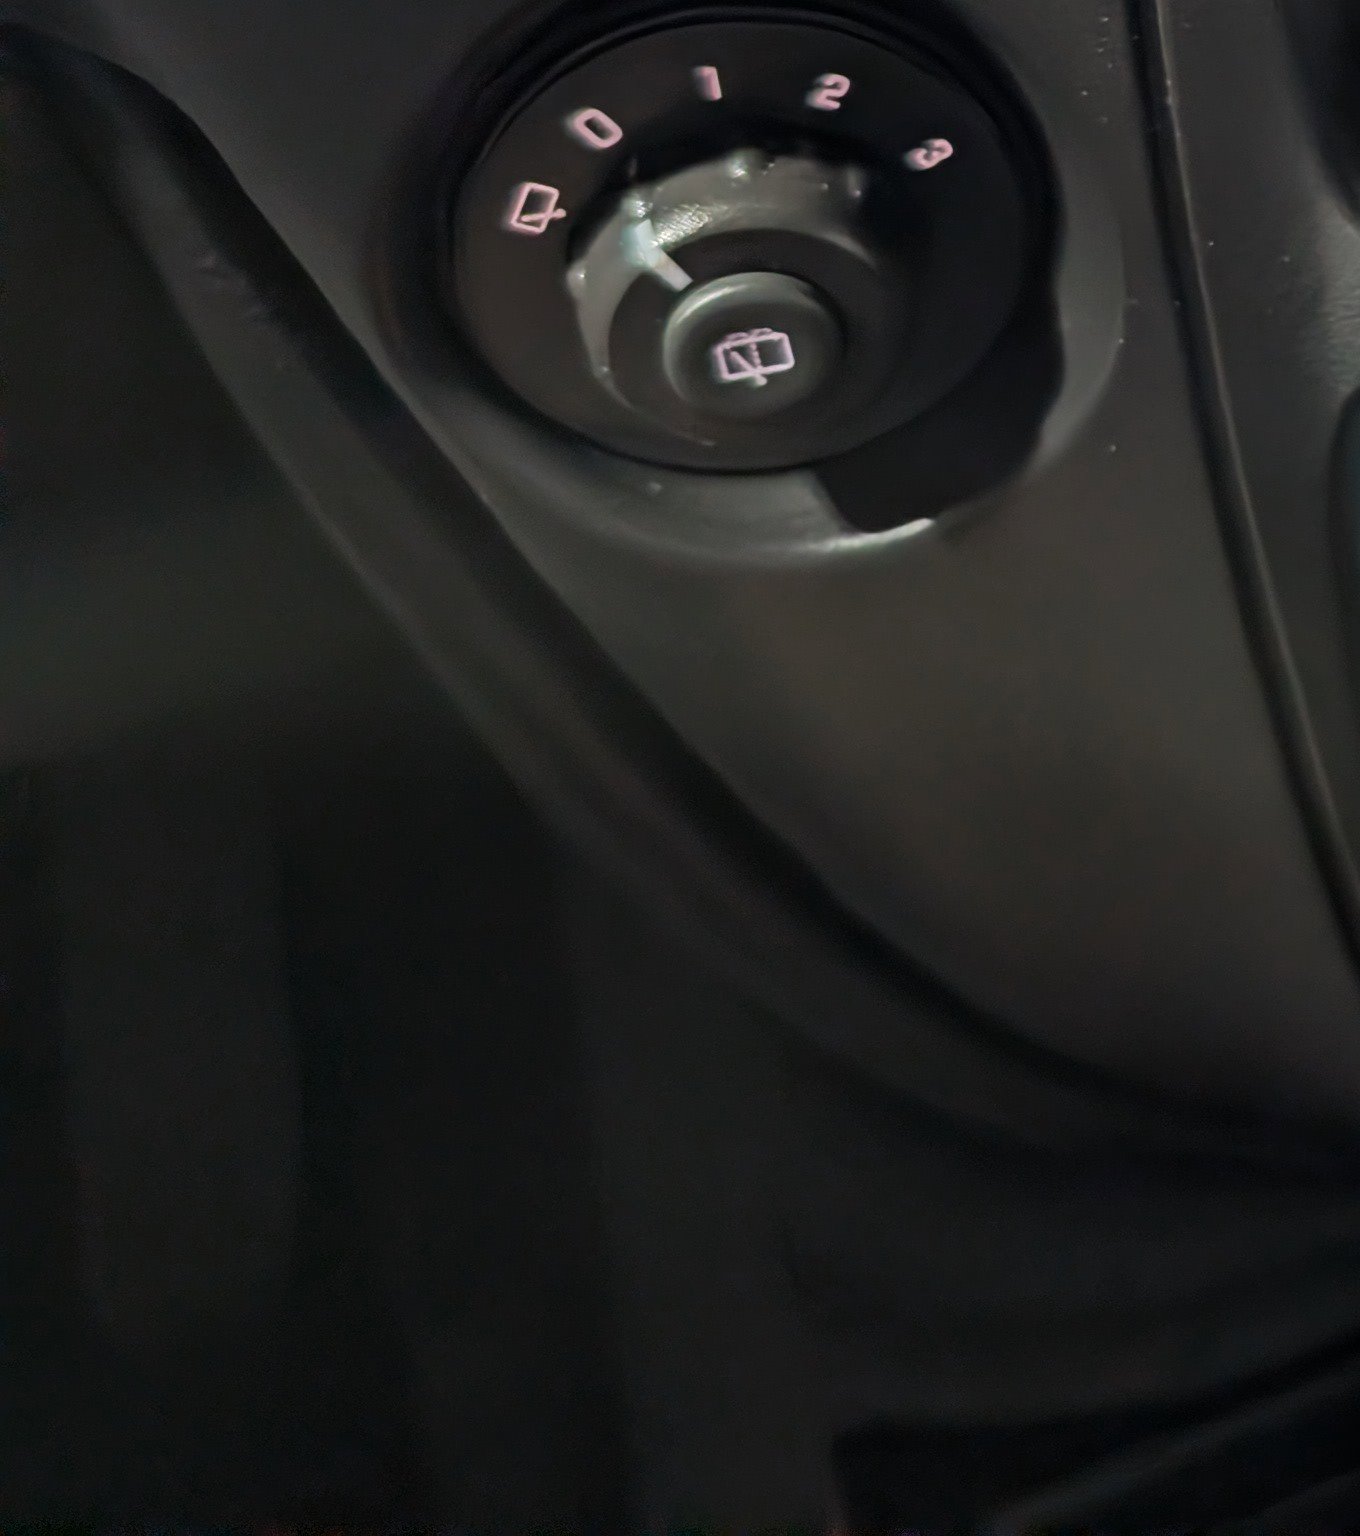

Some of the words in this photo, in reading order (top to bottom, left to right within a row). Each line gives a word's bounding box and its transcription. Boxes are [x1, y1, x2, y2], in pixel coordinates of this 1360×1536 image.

[694, 66, 722, 100] 1
[808, 74, 851, 111] 2
[570, 108, 623, 149] 0
[906, 138, 954, 170] 3
